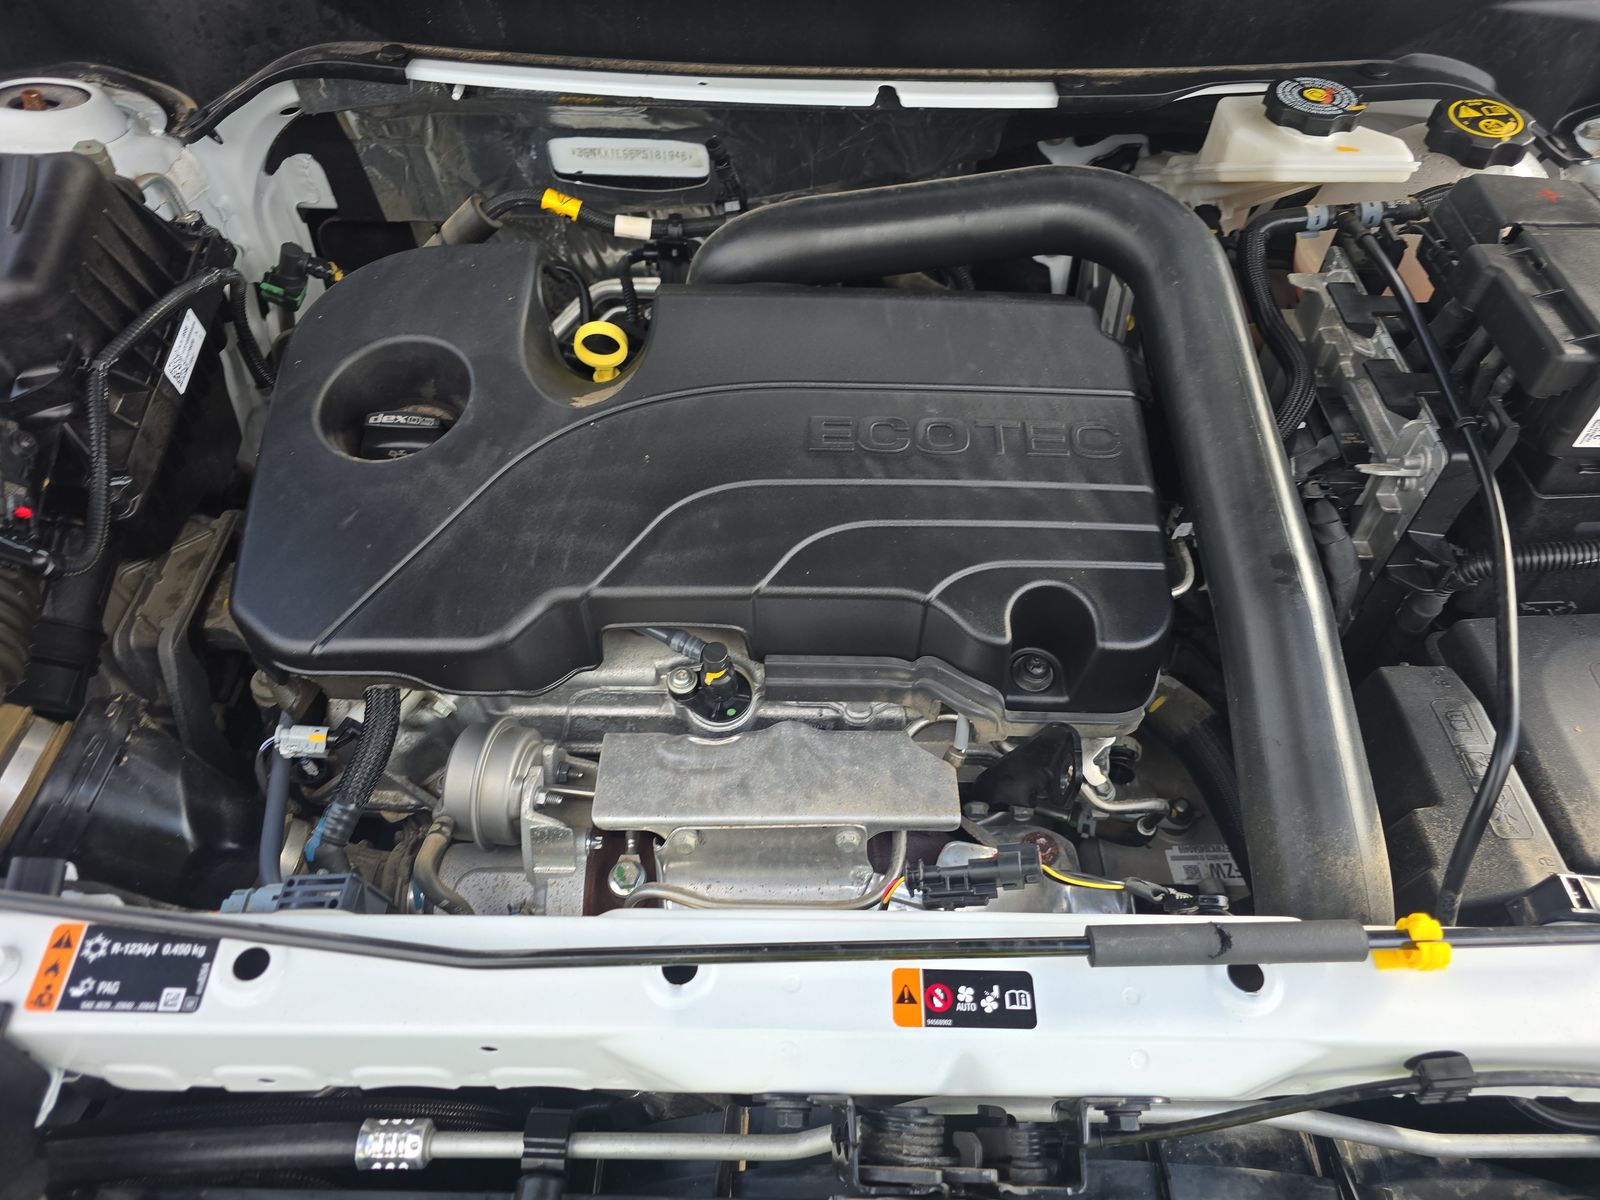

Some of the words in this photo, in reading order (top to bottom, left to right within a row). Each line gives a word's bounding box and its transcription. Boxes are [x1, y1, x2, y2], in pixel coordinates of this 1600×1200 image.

[807, 415, 1122, 460] ECOTEC
[110, 942, 160, 958] R-1234yf
[191, 943, 207, 959] kg
[96, 980, 121, 996] PAG
[955, 1002, 977, 1012] AUTO
